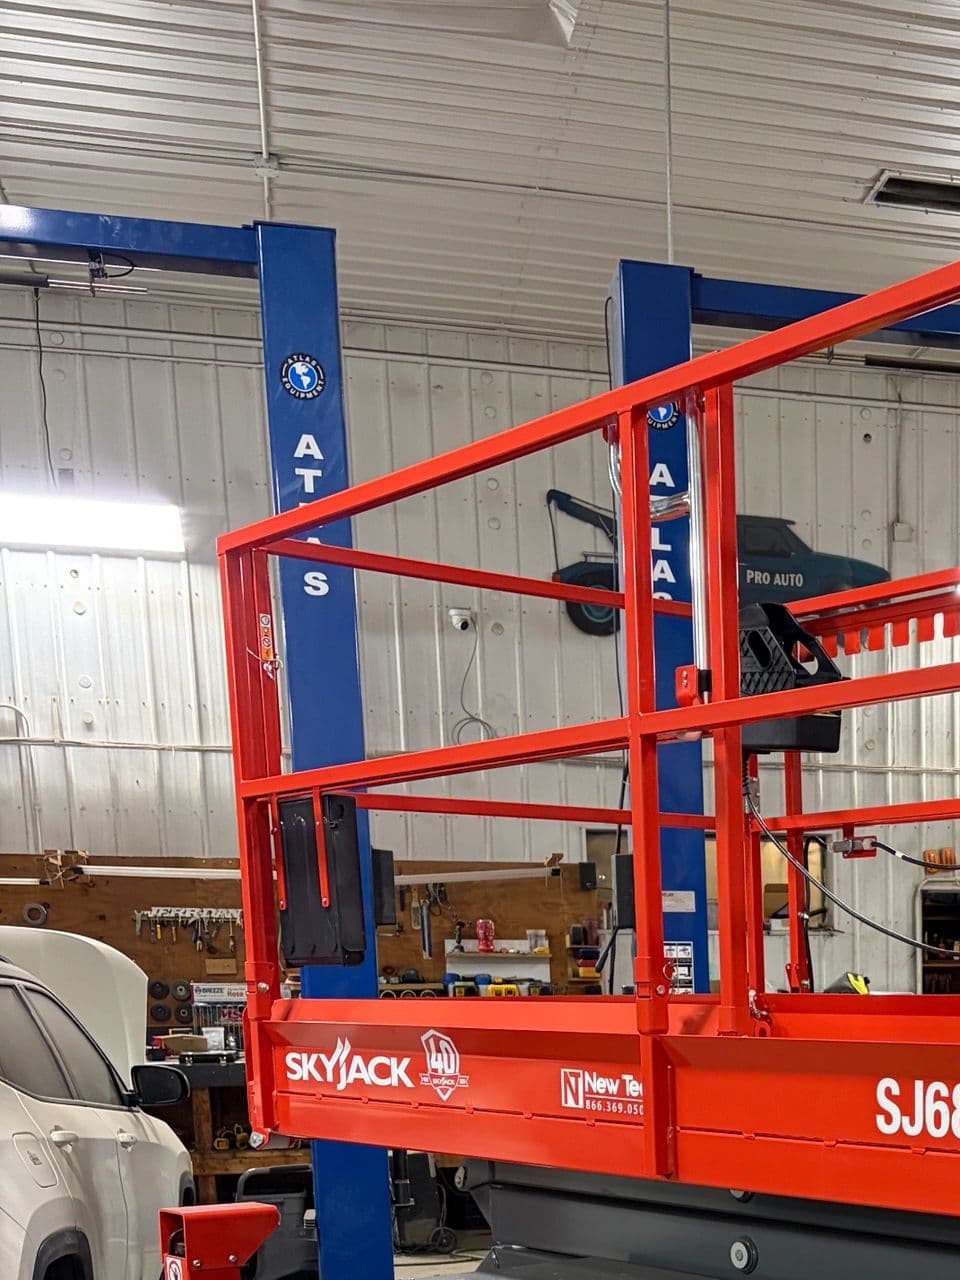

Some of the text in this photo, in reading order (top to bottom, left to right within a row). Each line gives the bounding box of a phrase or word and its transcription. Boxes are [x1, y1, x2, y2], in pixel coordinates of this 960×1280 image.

[293, 434, 330, 596] ATS
[746, 569, 804, 587] PRO AUTO
[286, 1036, 415, 1090] SKYJACK
[429, 1037, 453, 1075] 40
[585, 1071, 620, 1094] New
[585, 1100, 644, 1115] 866.369.050
